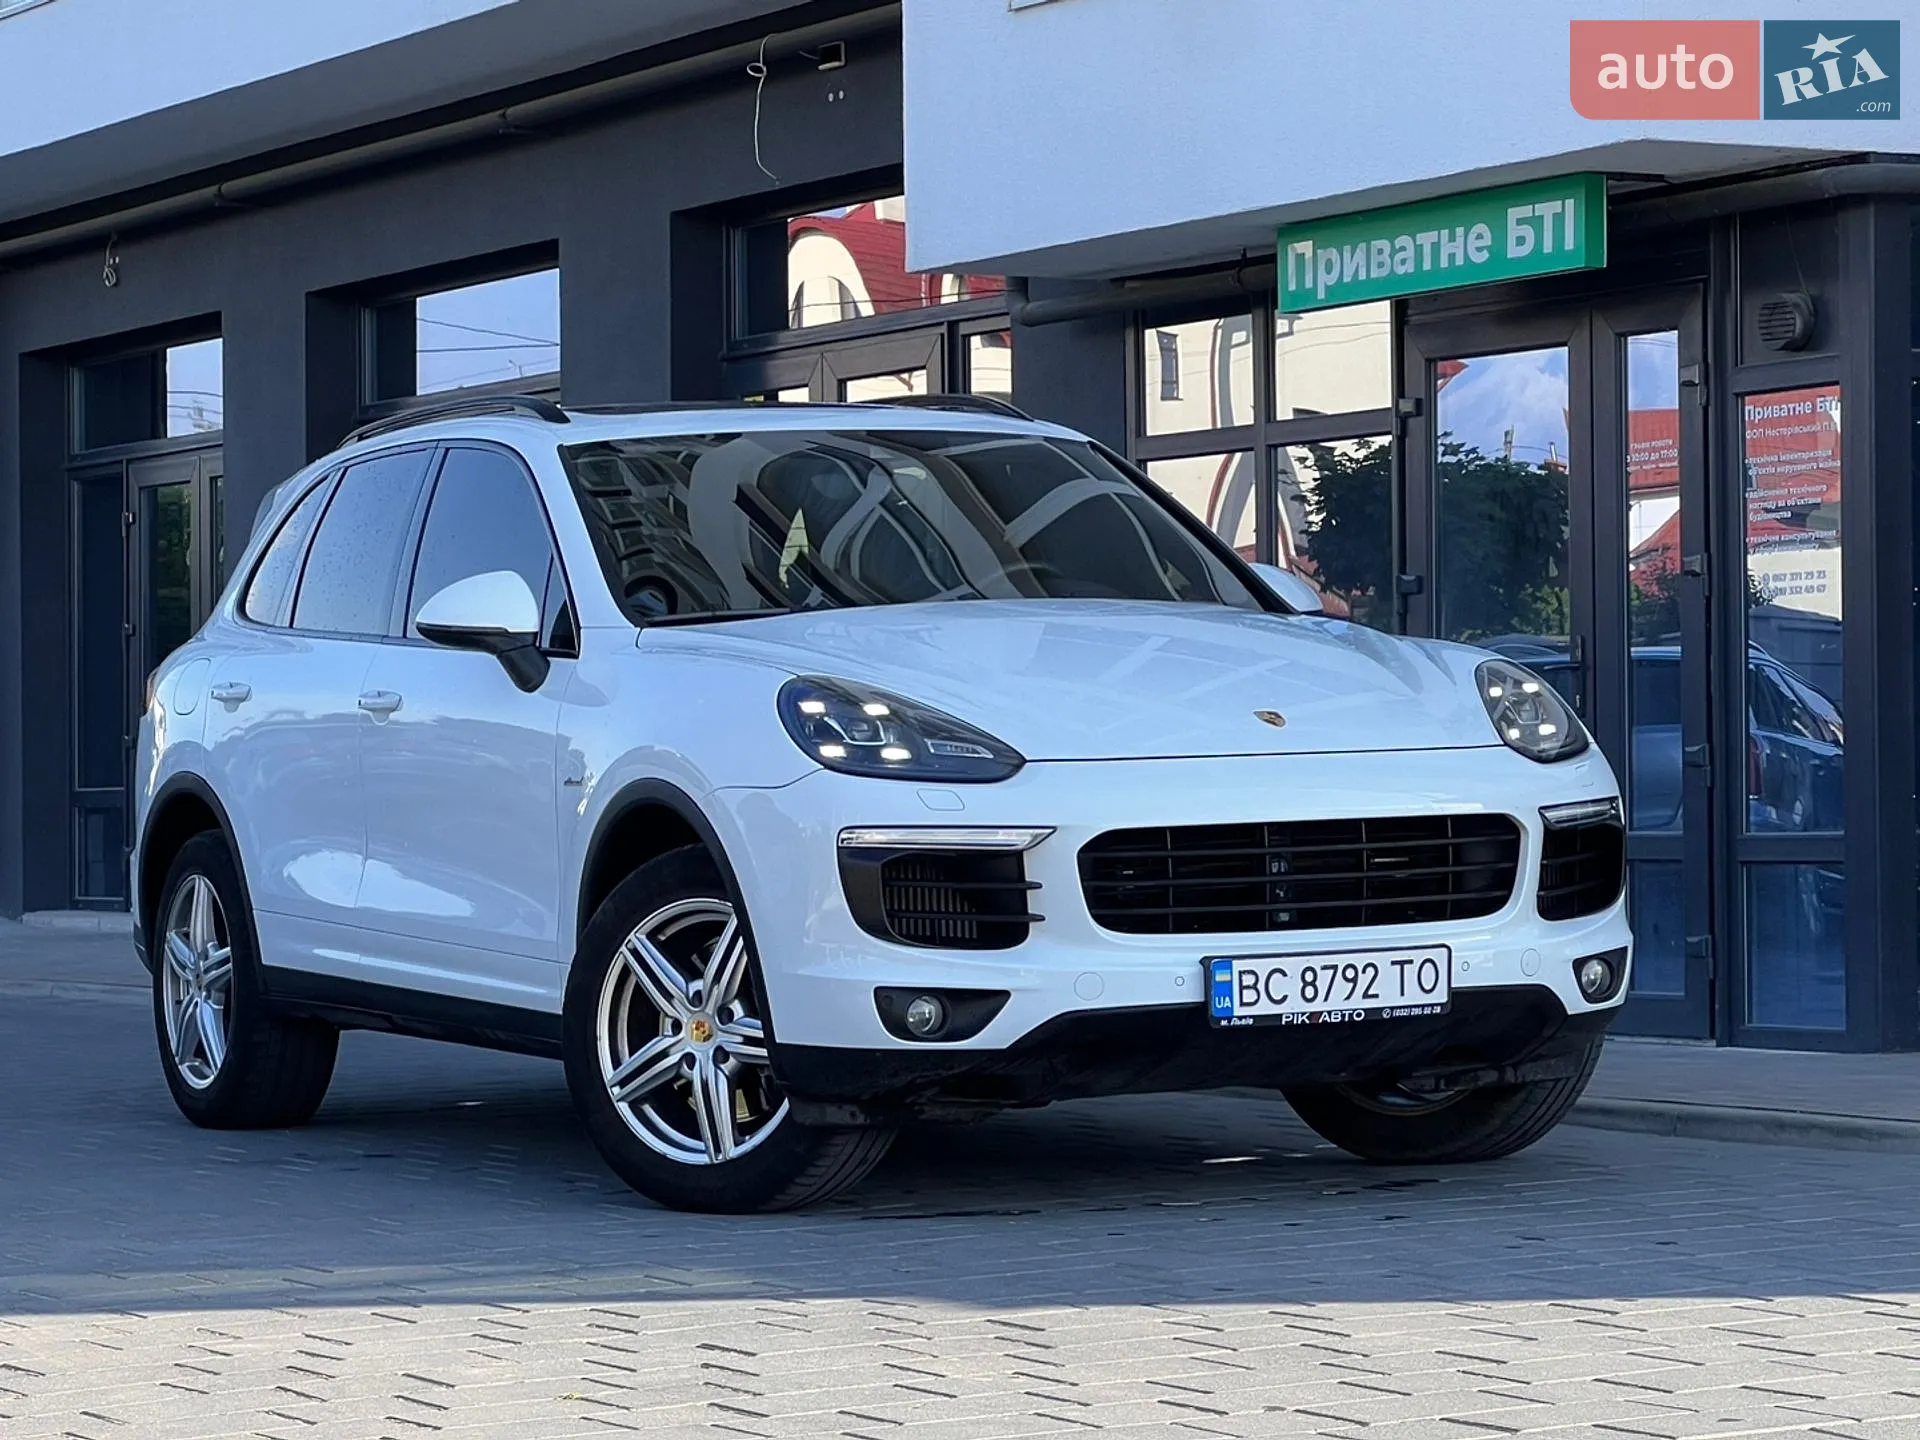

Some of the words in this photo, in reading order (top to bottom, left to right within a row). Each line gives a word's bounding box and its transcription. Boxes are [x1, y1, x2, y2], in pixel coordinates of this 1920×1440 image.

[1287, 222, 1492, 300] Приватне
[1506, 199, 1575, 259] БТІ
[1745, 401, 1812, 423] Приватне
[1238, 968, 1288, 1008] BC
[1300, 962, 1379, 1003] 8792
[1390, 957, 1440, 998] TO
[1215, 997, 1232, 1009] UA
[1318, 1009, 1366, 1024] АВТО
